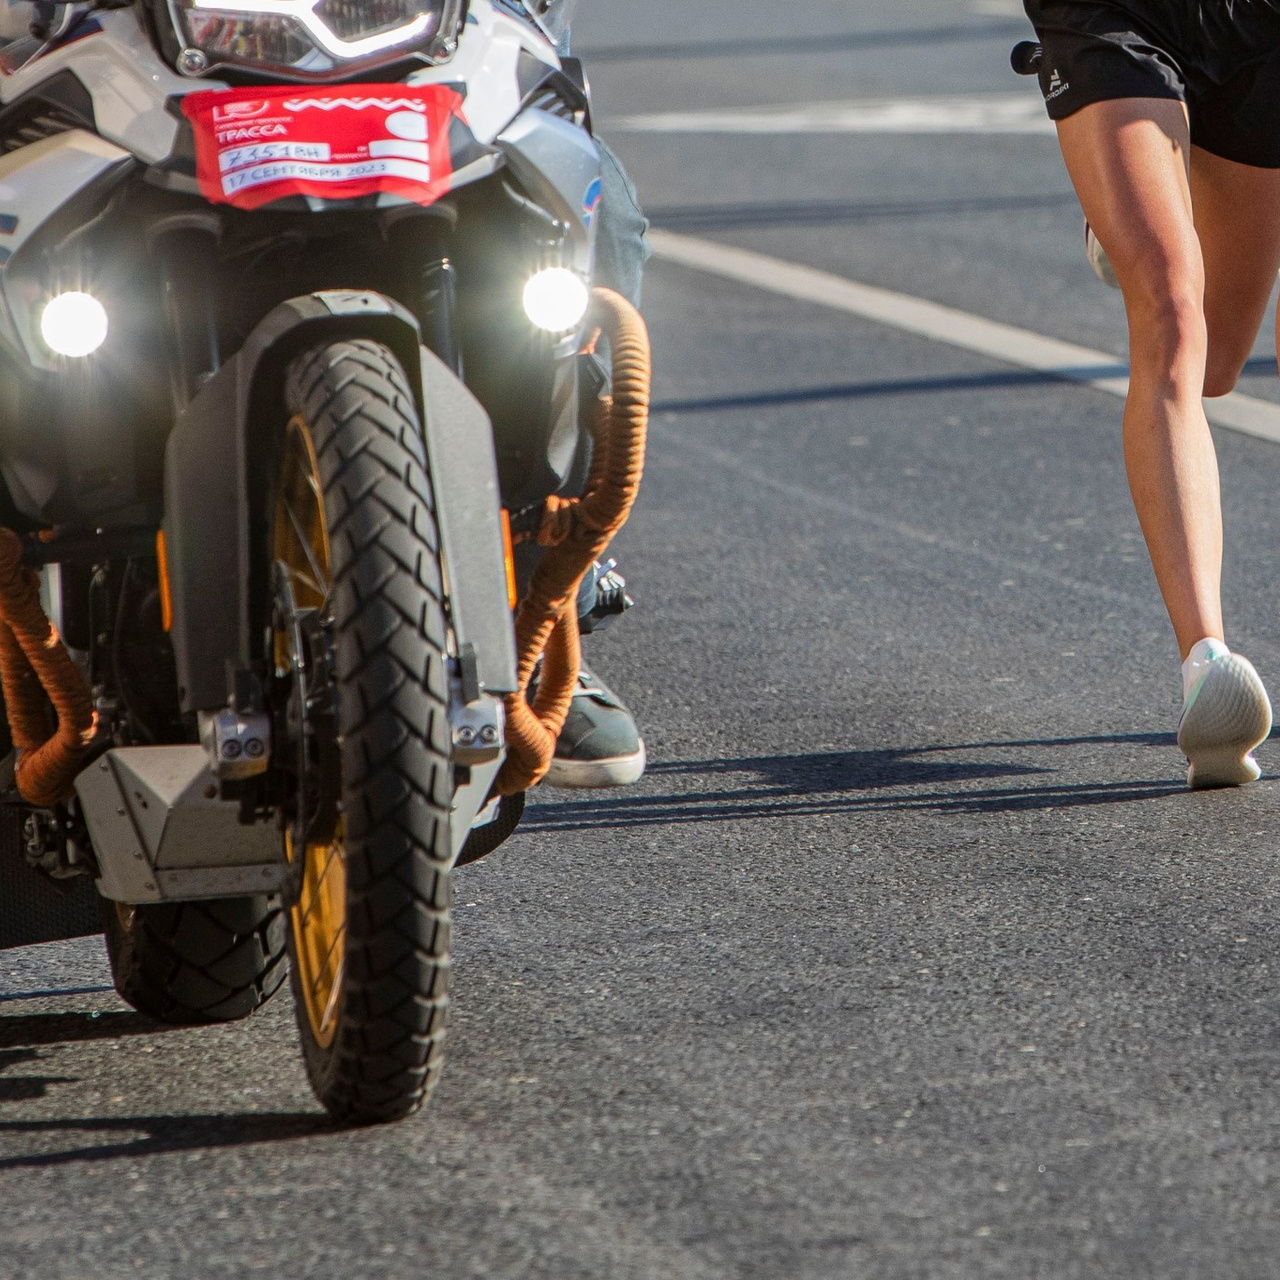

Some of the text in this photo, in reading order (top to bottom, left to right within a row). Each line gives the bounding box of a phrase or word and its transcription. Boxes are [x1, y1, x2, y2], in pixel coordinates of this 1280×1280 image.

[1046, 83, 1069, 101] ORDSKI
[216, 123, 288, 144] ТРАССА
[229, 173, 246, 189] 17
